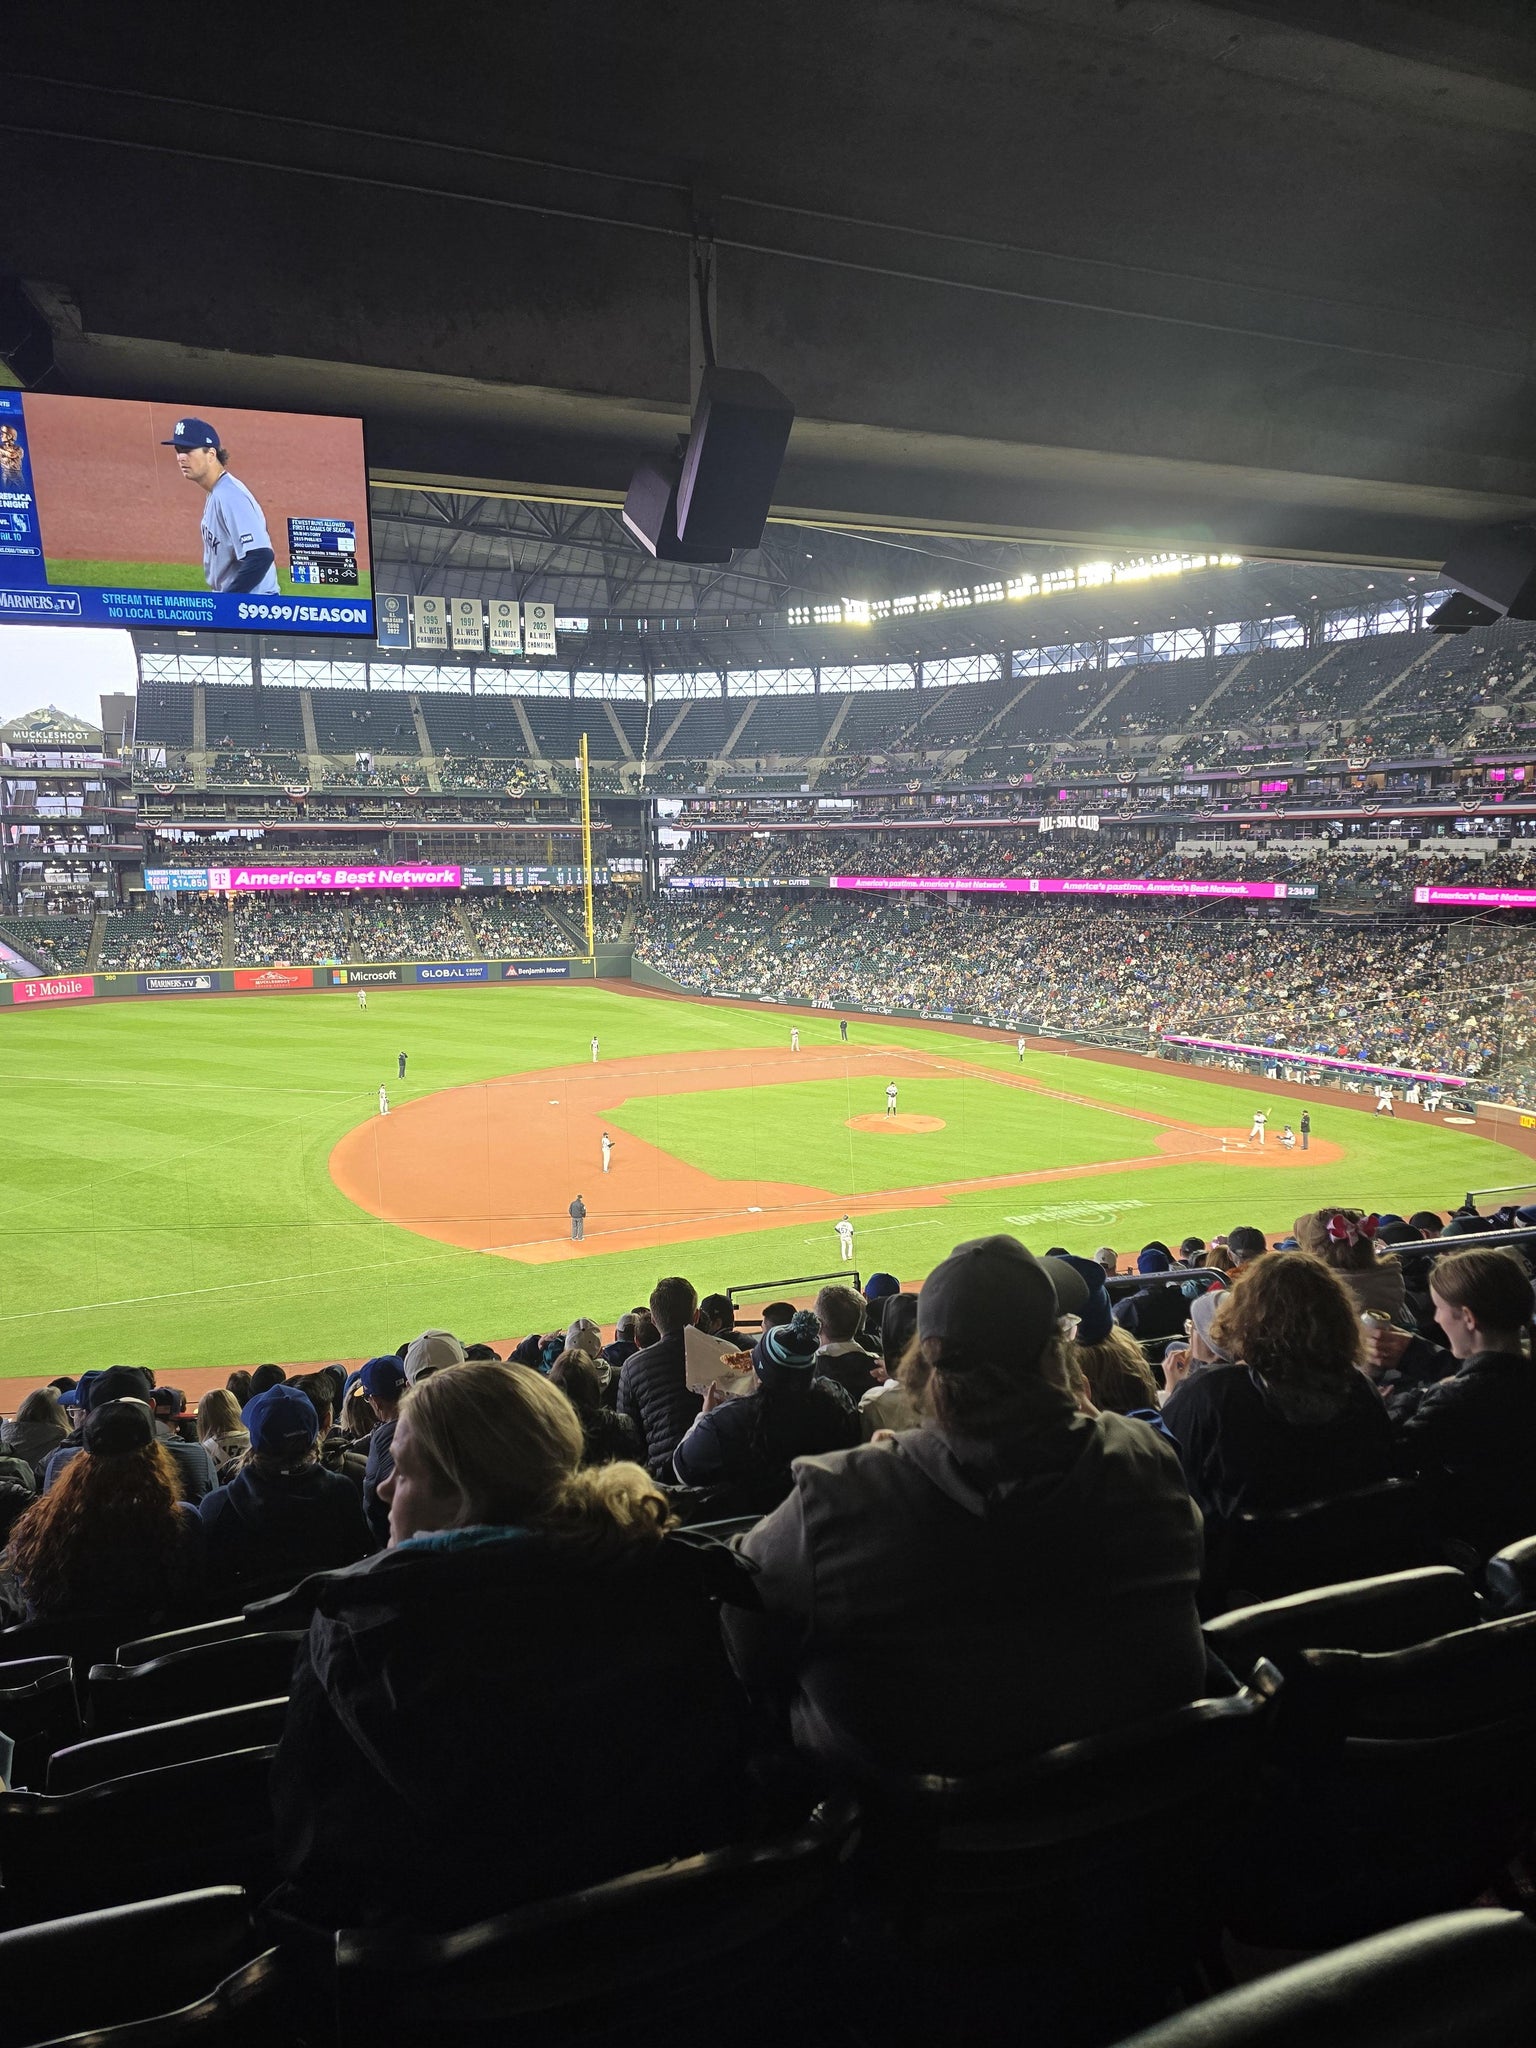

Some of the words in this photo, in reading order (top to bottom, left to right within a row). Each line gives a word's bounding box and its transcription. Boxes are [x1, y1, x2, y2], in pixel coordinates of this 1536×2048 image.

[13, 533, 22, 541] 10
[102, 593, 143, 605] STREAM
[143, 595, 163, 606] THE
[164, 596, 217, 609] MARINERS,
[109, 607, 123, 617] NO
[125, 608, 156, 619] LOCAL
[157, 609, 213, 621] BLACKOUTS
[238, 602, 367, 623] $99.99/SEASON
[460, 617, 474, 626] 1997
[533, 621, 547, 630] 2025
[429, 627, 443, 635] WEST
[466, 629, 479, 637] WEST
[503, 630, 516, 638] WEST
[417, 635, 446, 644] CHAMPIONS
[539, 632, 551, 640] WEST
[454, 637, 482, 646] CHAMPIONS
[491, 639, 519, 648] CHAMPIONS
[527, 641, 554, 649] CHAMPIONS
[13, 730, 89, 740] MUCKLESHOOT
[1077, 815, 1099, 831] CLUB
[235, 871, 331, 885] America's
[334, 870, 376, 884] Best
[378, 869, 455, 883] Network
[172, 879, 208, 887] $14,850
[1062, 882, 1106, 891] America's
[1146, 883, 1190, 892] America's
[1190, 884, 1209, 892] Best
[1430, 891, 1477, 900] America's
[1477, 892, 1500, 901] Best
[350, 969, 397, 981] Microsoft
[421, 968, 465, 978] GLOBAL
[517, 967, 546, 975] Benjamin
[39, 980, 83, 996] Mobile
[811, 1000, 836, 1009] STIHL
[861, 1005, 879, 1013] Great
[878, 1005, 893, 1015] Clips
